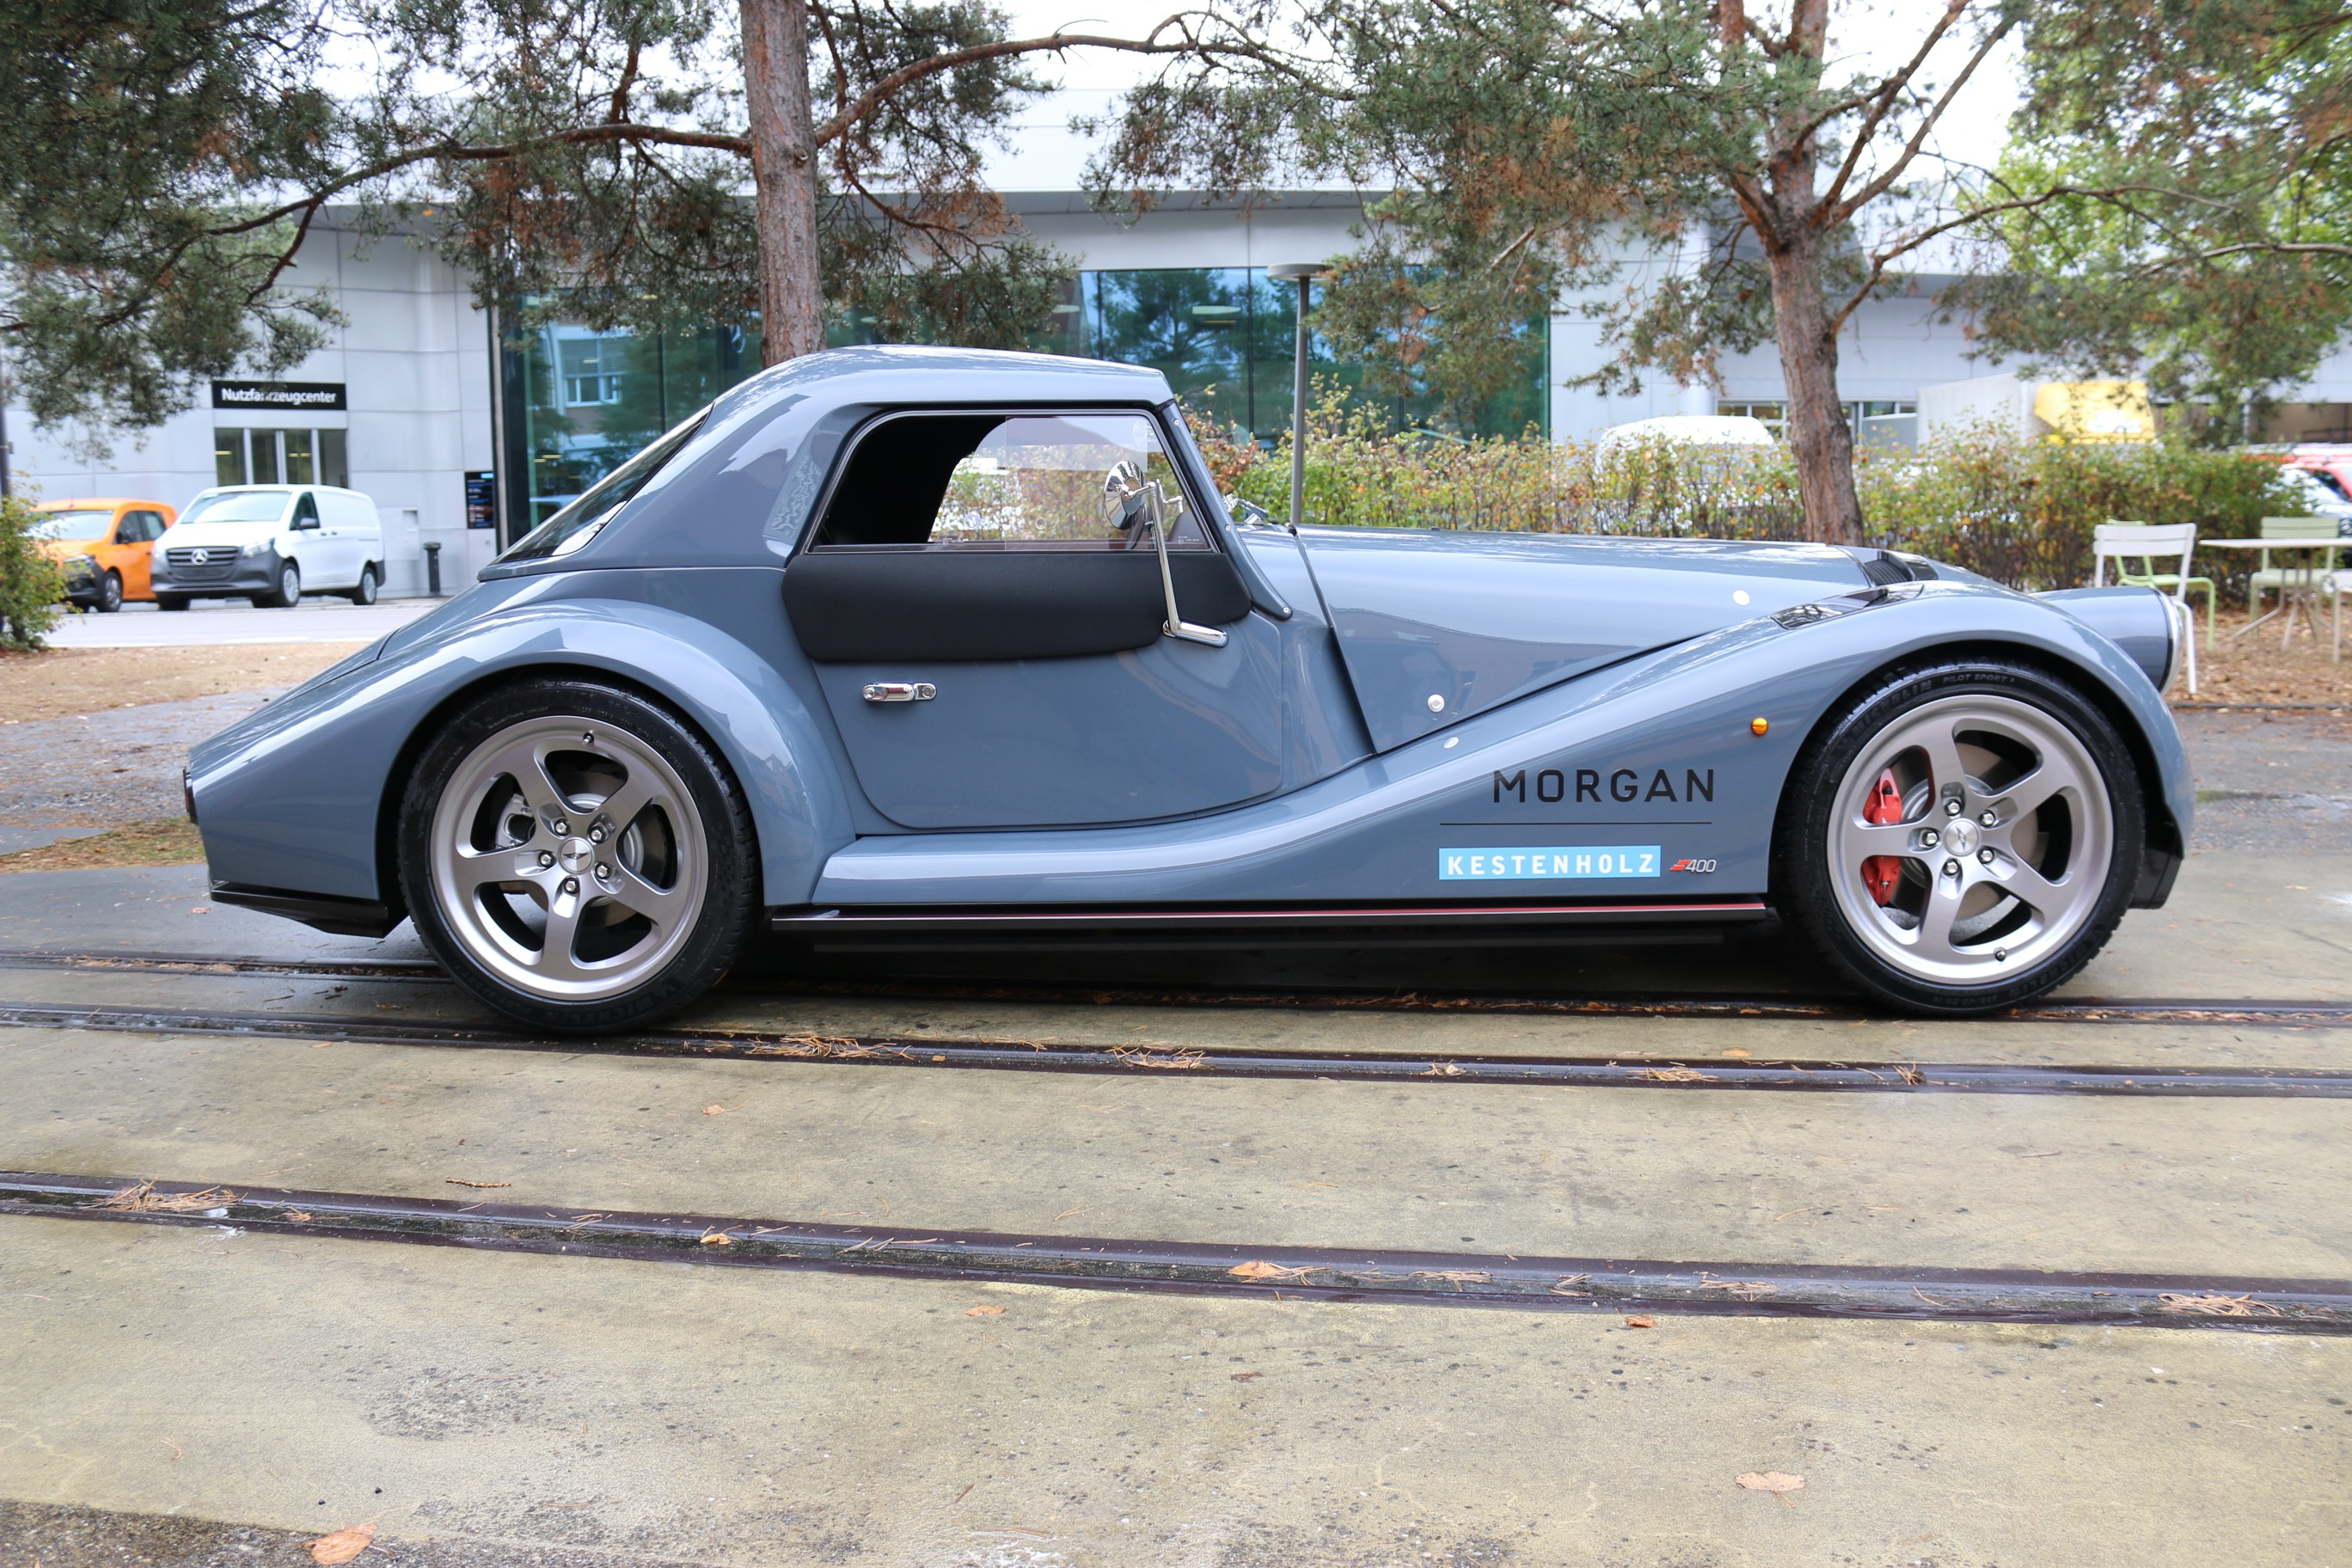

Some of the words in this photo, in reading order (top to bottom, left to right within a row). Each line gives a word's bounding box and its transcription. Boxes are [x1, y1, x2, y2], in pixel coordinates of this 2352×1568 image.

[1943, 674, 1971, 683] PILOT
[1975, 673, 2008, 683] SPORT
[1493, 769, 1714, 803] MORGAN
[1448, 854, 1653, 875] KESTENHOLZ
